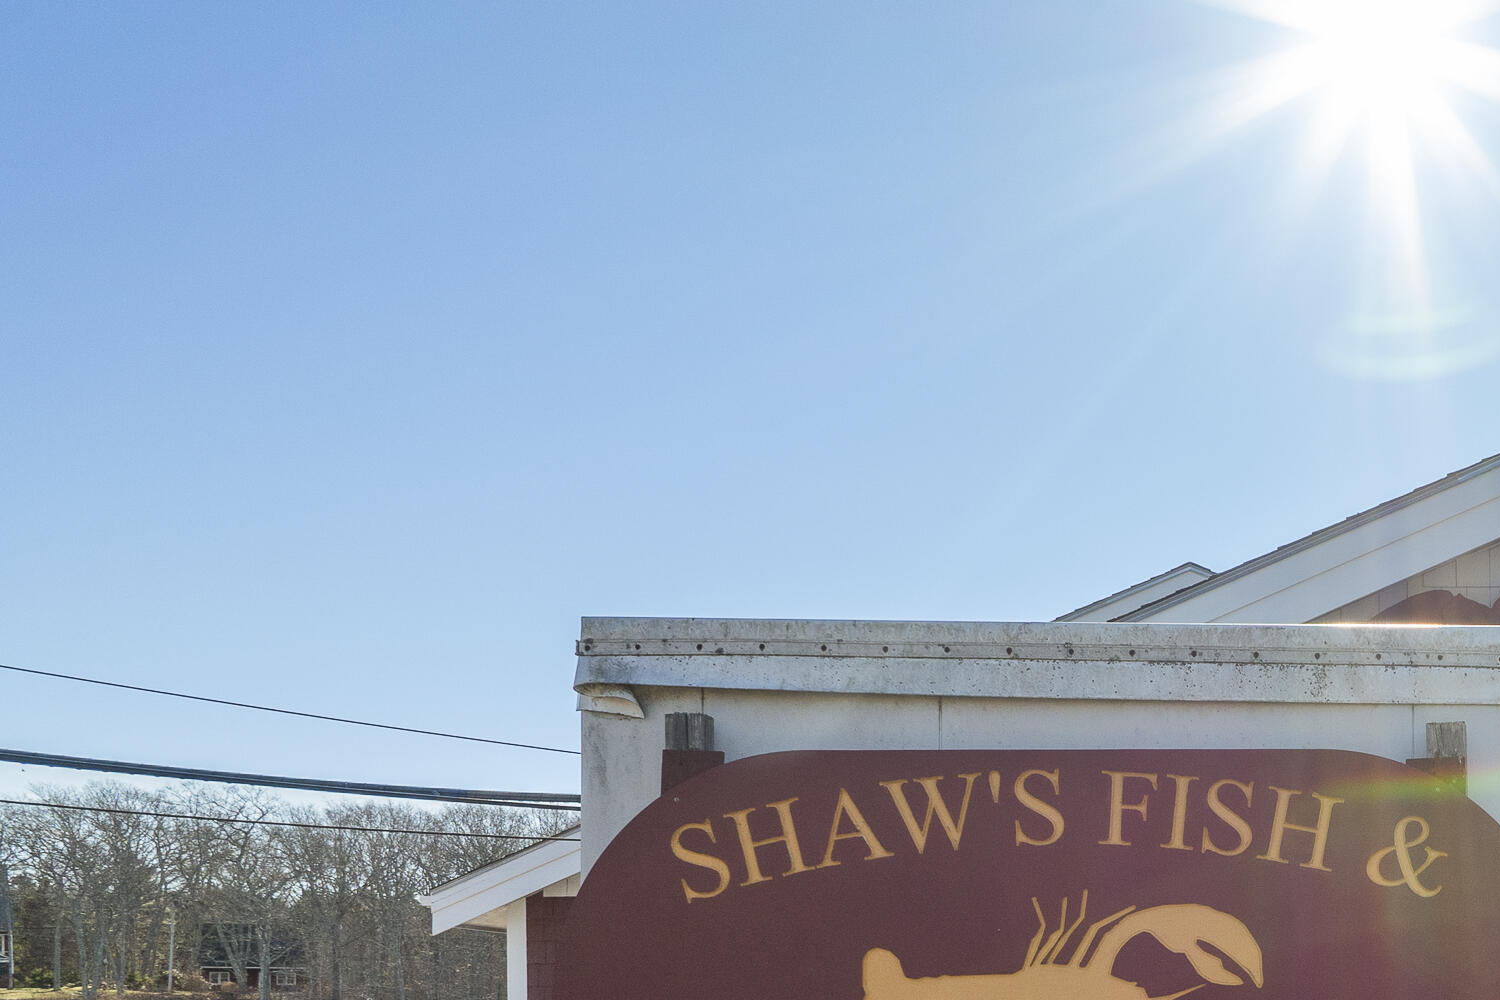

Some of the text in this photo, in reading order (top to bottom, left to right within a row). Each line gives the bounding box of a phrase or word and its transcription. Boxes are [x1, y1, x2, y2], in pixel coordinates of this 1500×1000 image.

[670, 769, 1448, 904] SHAW'S FISH &
